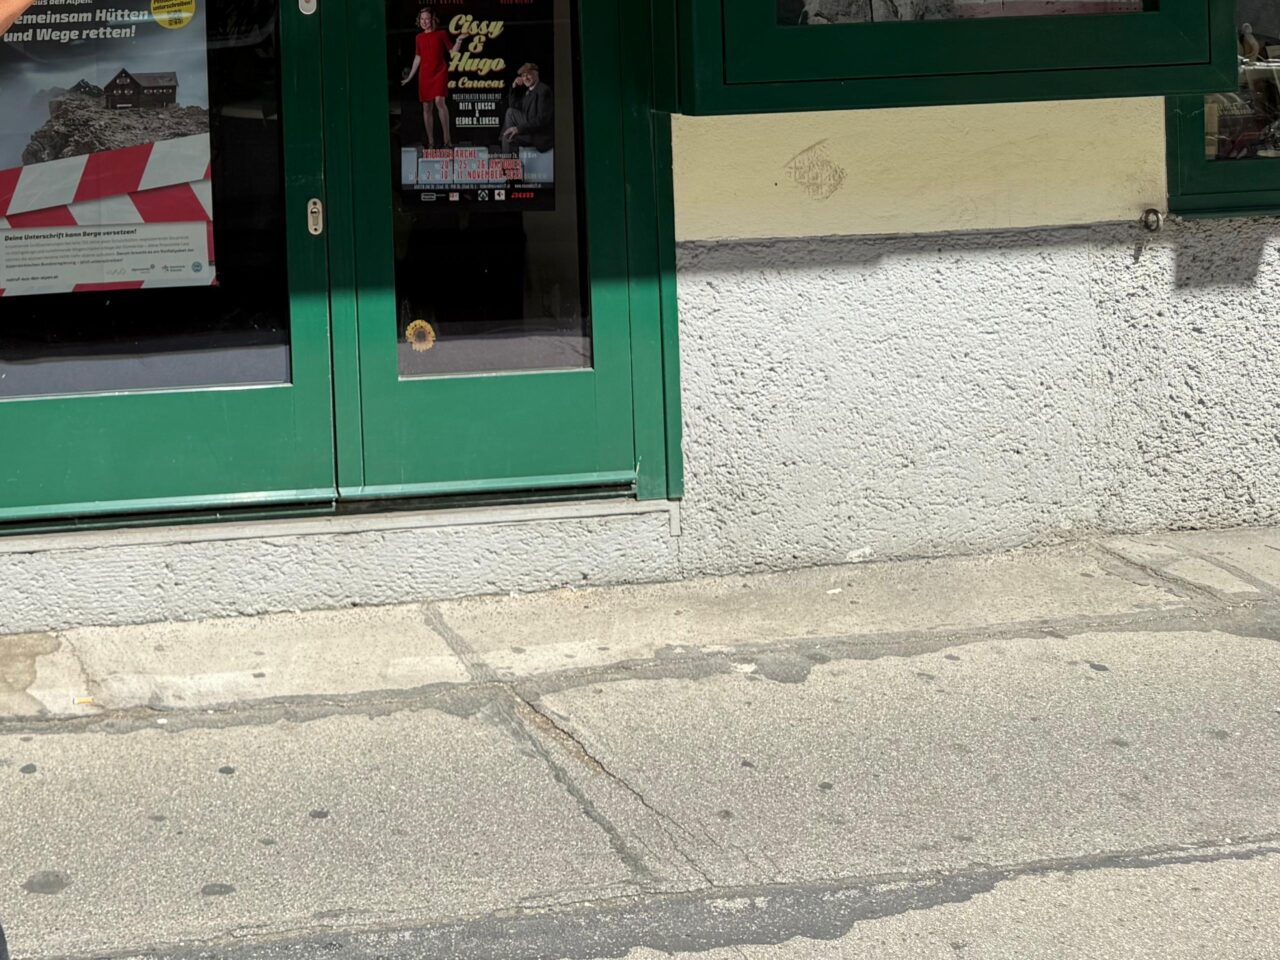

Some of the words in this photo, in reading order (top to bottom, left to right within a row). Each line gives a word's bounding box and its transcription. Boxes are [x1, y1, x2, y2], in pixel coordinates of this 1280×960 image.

[14, 10, 92, 25] emeinsam
[95, 8, 148, 21] Hütten
[4, 29, 33, 42] und
[36, 28, 79, 44] Wege
[82, 25, 136, 40] retten!
[448, 14, 504, 39] Cissy
[468, 35, 486, 53] &
[448, 51, 506, 76] Hugo
[447, 81, 457, 89] a
[458, 76, 505, 89] Caracas
[24, 232, 64, 241] Unterschrift
[65, 231, 81, 239] kann
[82, 230, 101, 239] Berge
[102, 229, 137, 237] versetzen!
